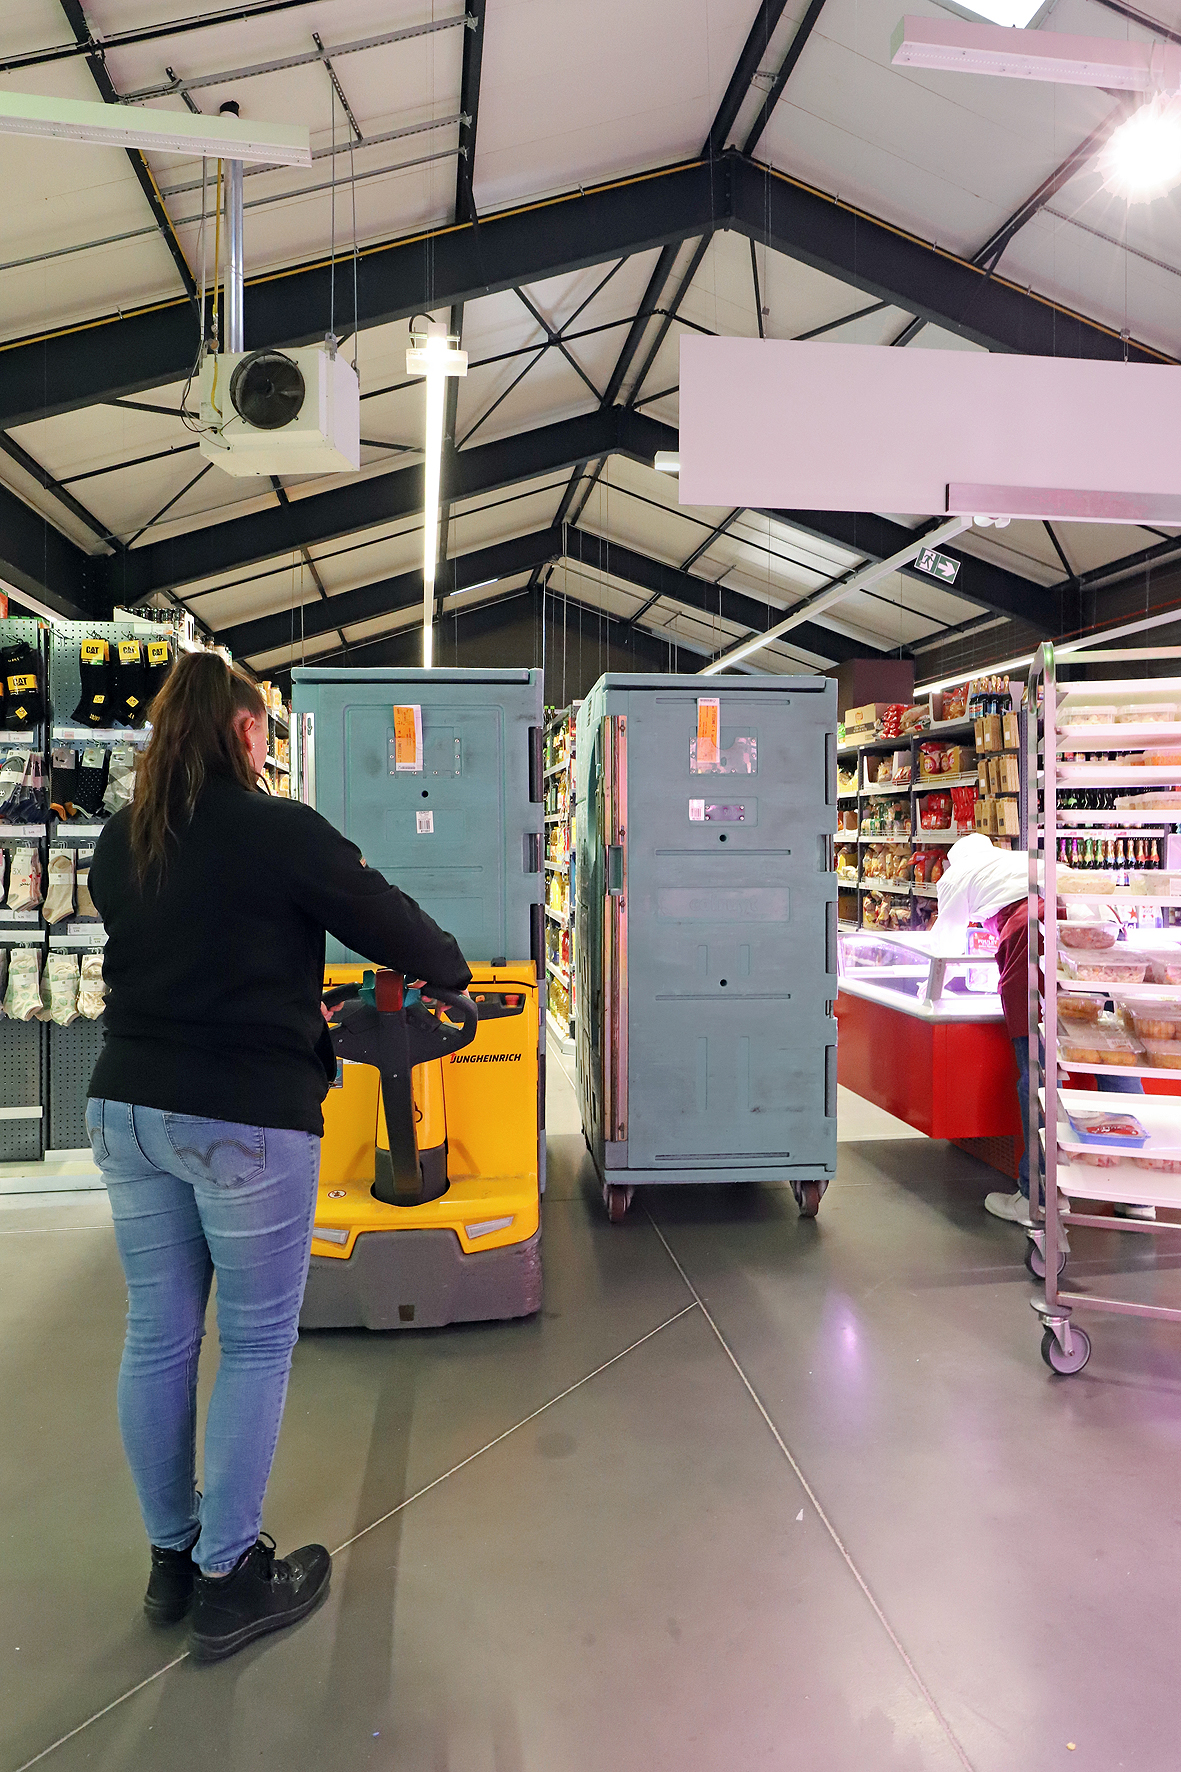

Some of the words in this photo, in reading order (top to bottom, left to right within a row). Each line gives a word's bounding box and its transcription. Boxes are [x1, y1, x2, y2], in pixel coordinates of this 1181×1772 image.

[86, 646, 99, 654] CAT
[123, 646, 136, 654] CAT
[152, 648, 164, 657] CAT
[13, 677, 27, 686] CAT
[450, 1053, 522, 1064] JUNGHEINRICH
